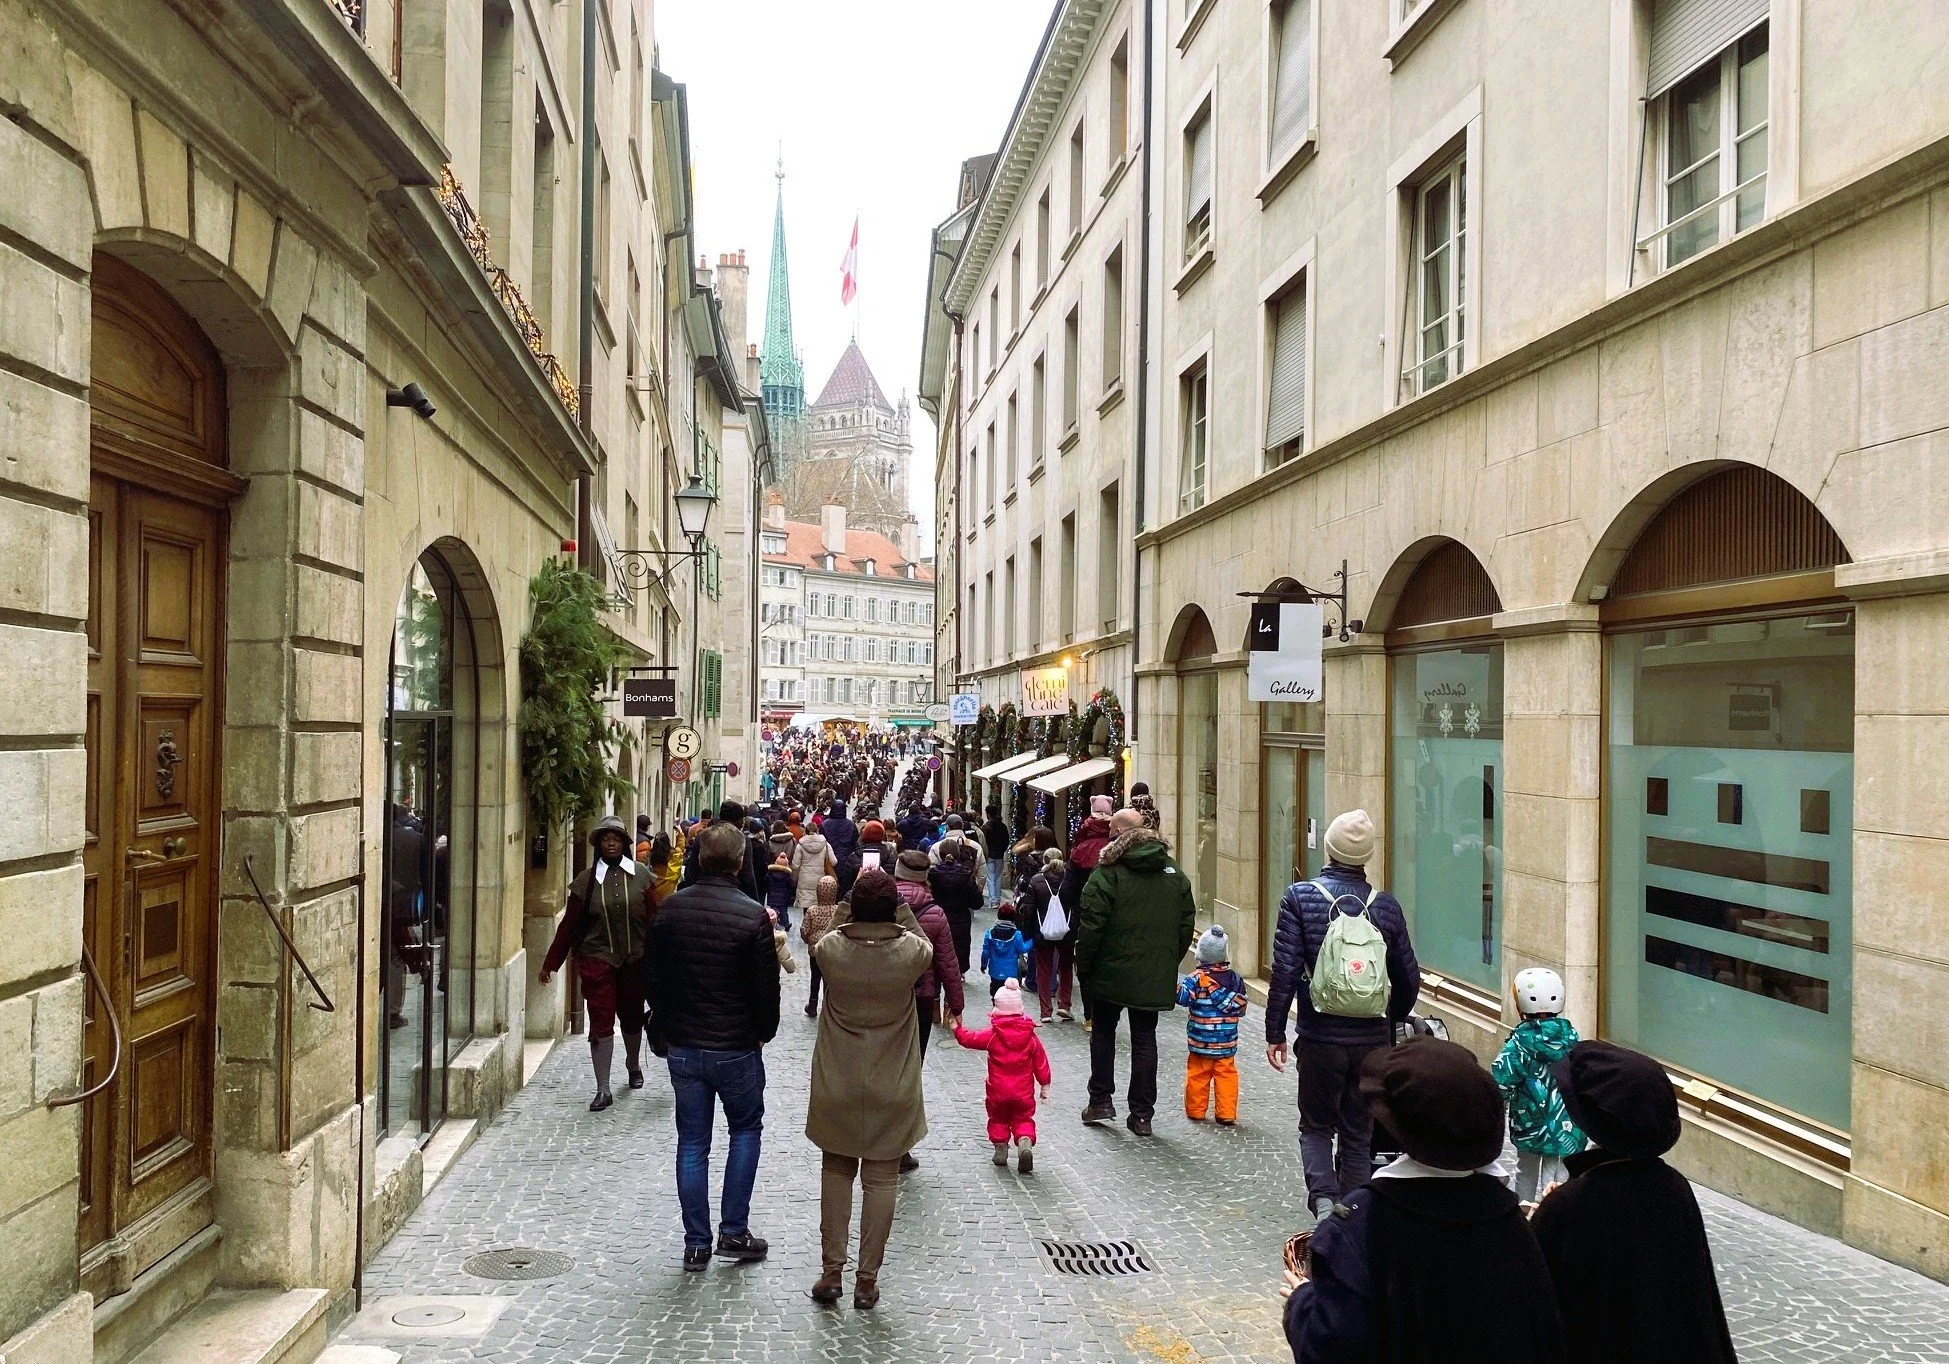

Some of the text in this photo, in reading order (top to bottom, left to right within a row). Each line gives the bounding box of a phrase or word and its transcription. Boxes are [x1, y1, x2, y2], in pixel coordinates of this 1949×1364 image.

[1258, 618, 1273, 633] La
[1025, 675, 1065, 690] demi
[625, 693, 674, 703] Bonhams
[1270, 680, 1315, 701] Gallery
[676, 733, 692, 754] g
